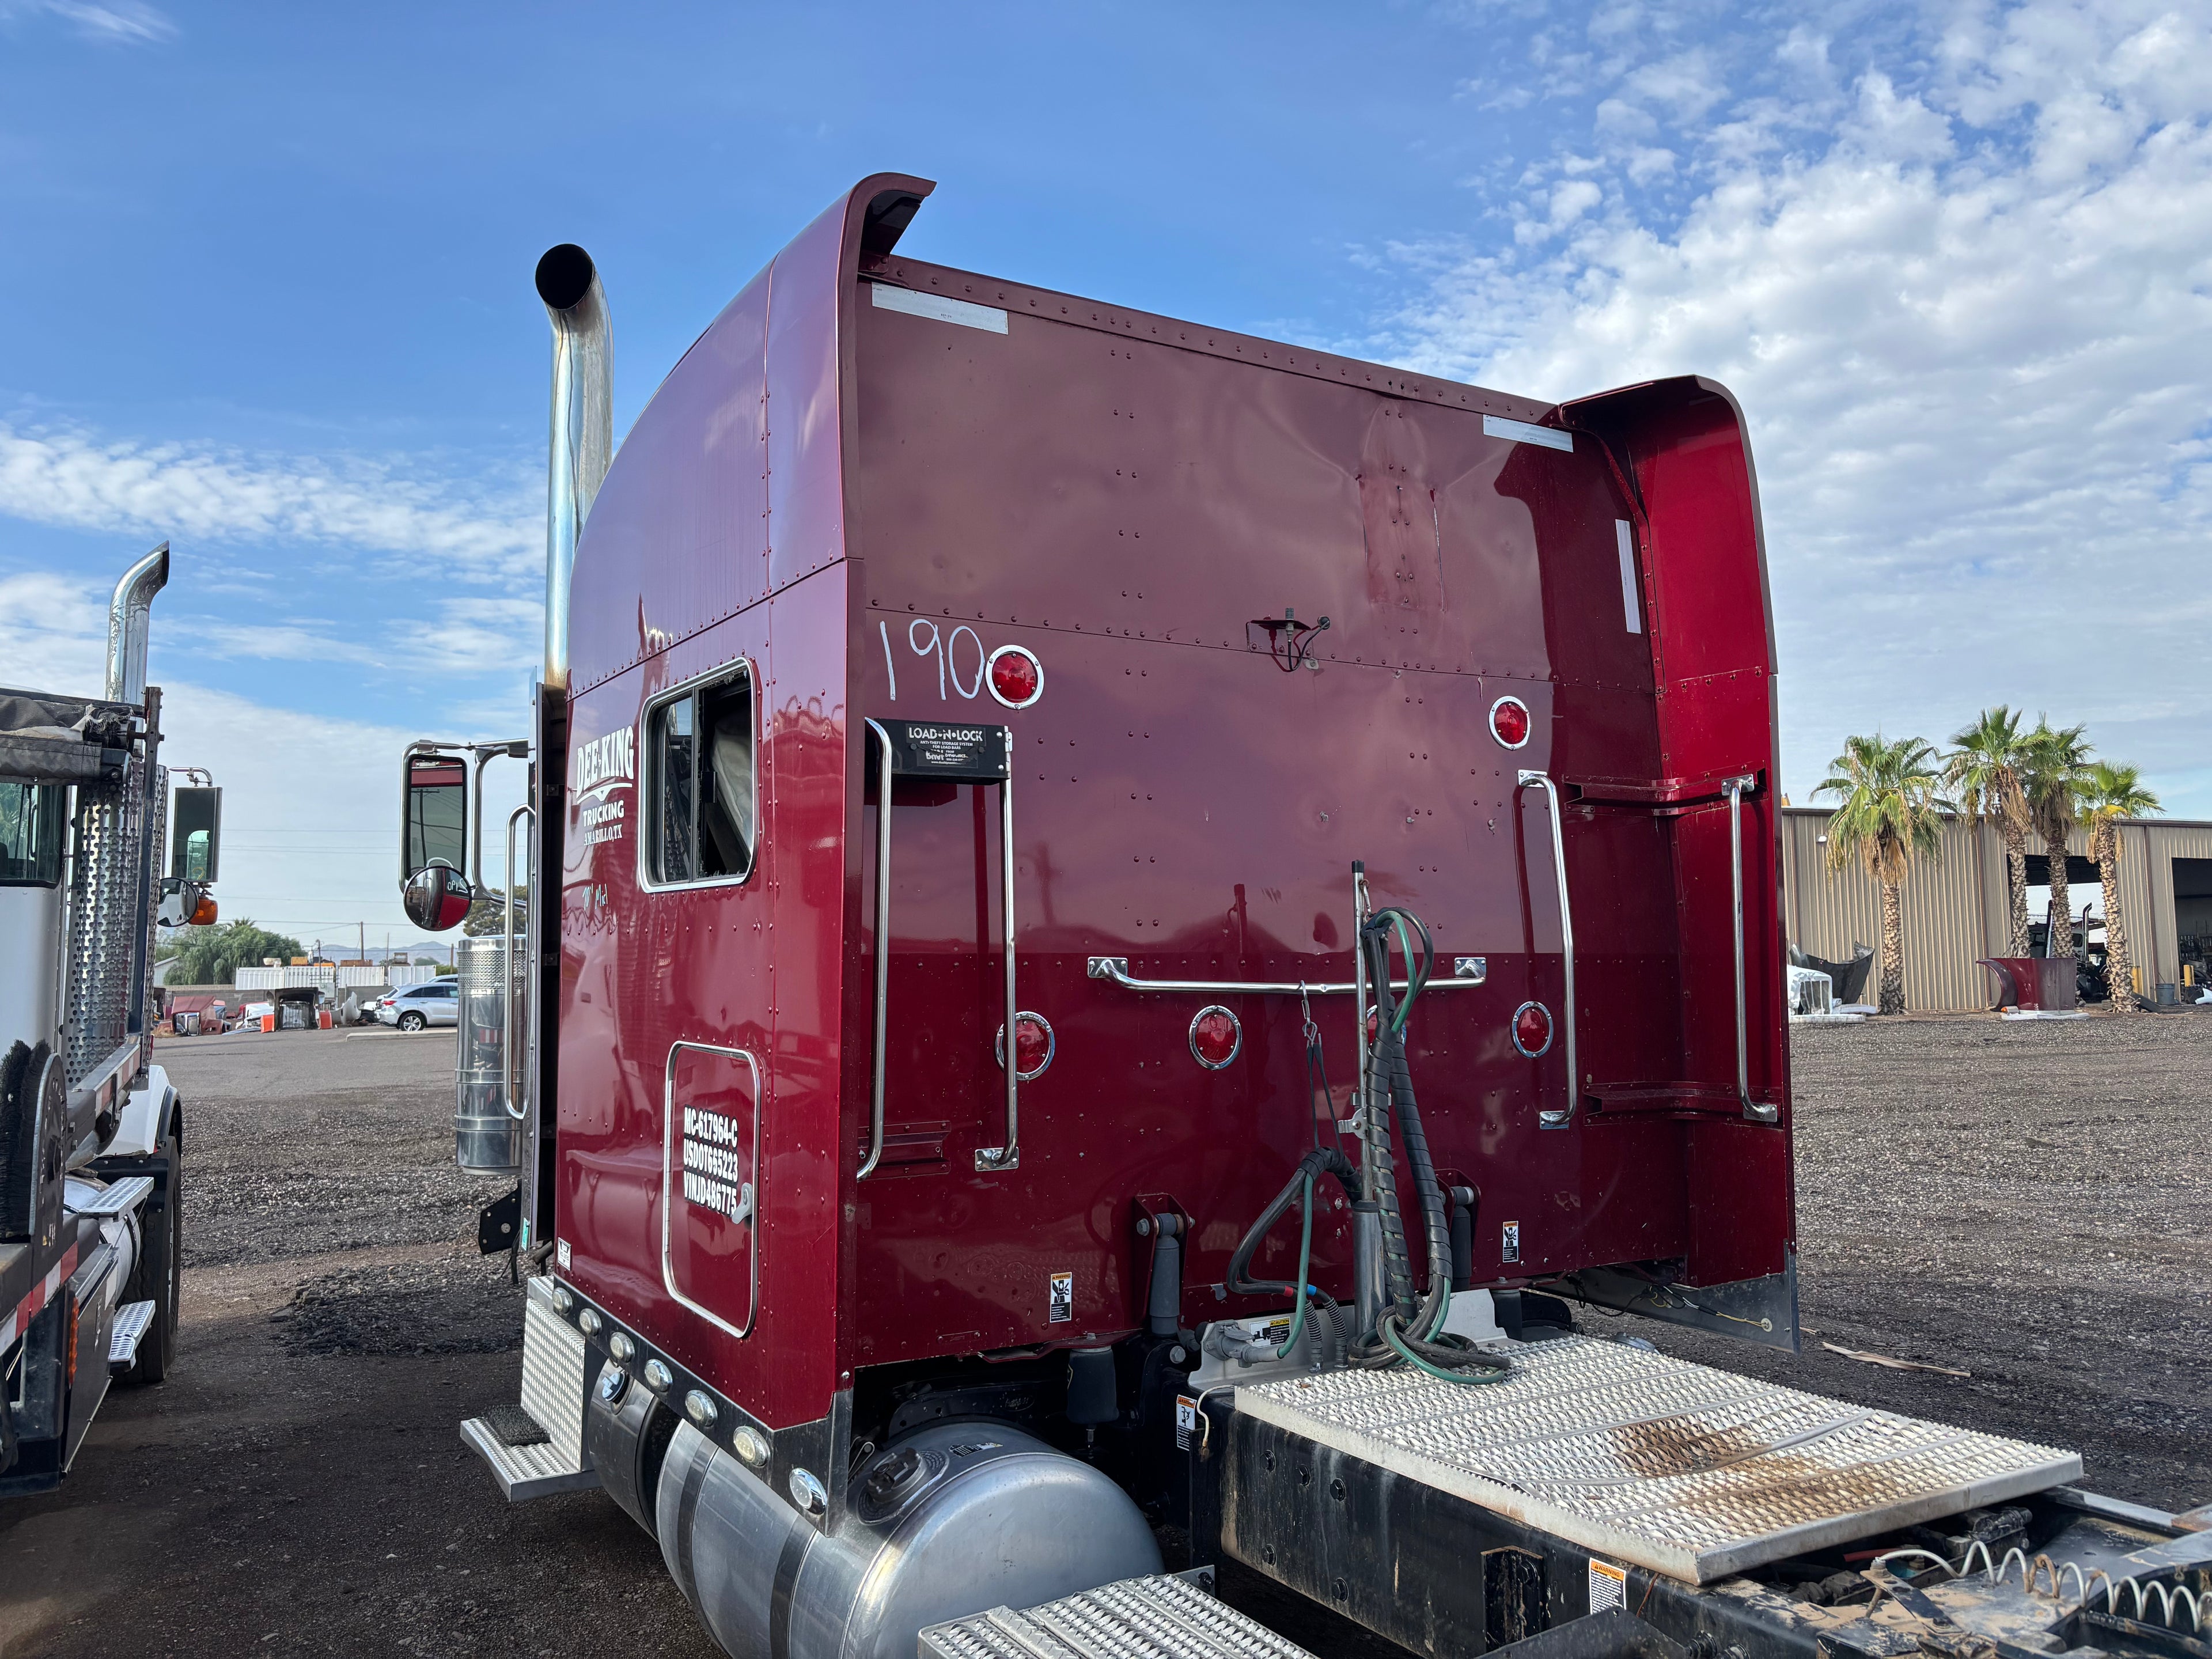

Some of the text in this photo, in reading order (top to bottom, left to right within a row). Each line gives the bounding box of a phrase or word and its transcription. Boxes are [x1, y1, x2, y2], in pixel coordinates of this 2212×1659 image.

[880, 618, 986, 701] 190
[583, 800, 625, 827] TRUCKING
[684, 1107, 738, 1148] MC-617964-C
[1598, 1565, 1620, 1577] WARNING
